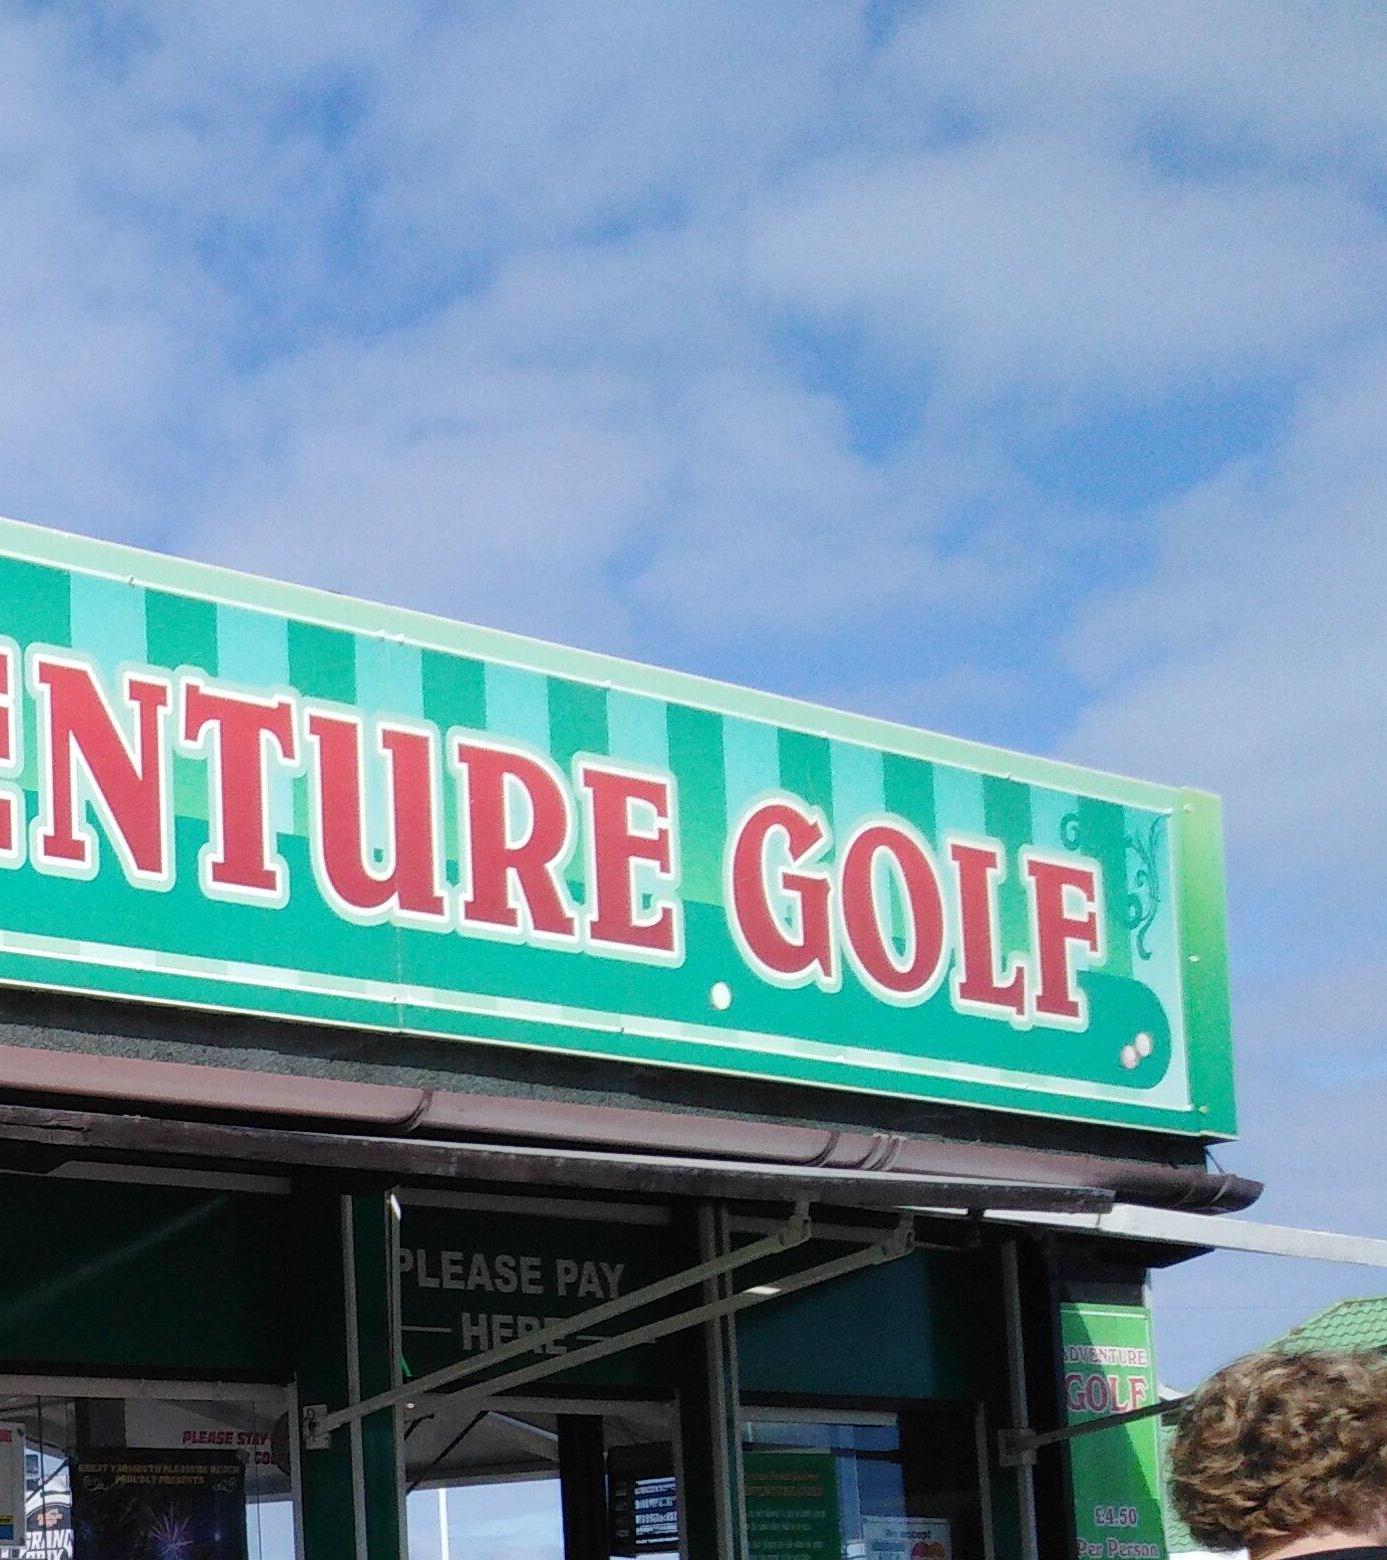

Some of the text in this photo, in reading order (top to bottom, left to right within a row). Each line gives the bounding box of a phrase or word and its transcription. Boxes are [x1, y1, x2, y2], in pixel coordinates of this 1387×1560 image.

[732, 801, 1102, 1023] GOLF
[399, 1248, 625, 1299] PLEASE PAY
[1065, 1347, 1147, 1365] DVENTURE
[1065, 1374, 1147, 1413] GOLF
[182, 1430, 268, 1446] PLEASE STAY
[1095, 1506, 1137, 1526] £4.50
[1108, 1540, 1159, 1558] Person
